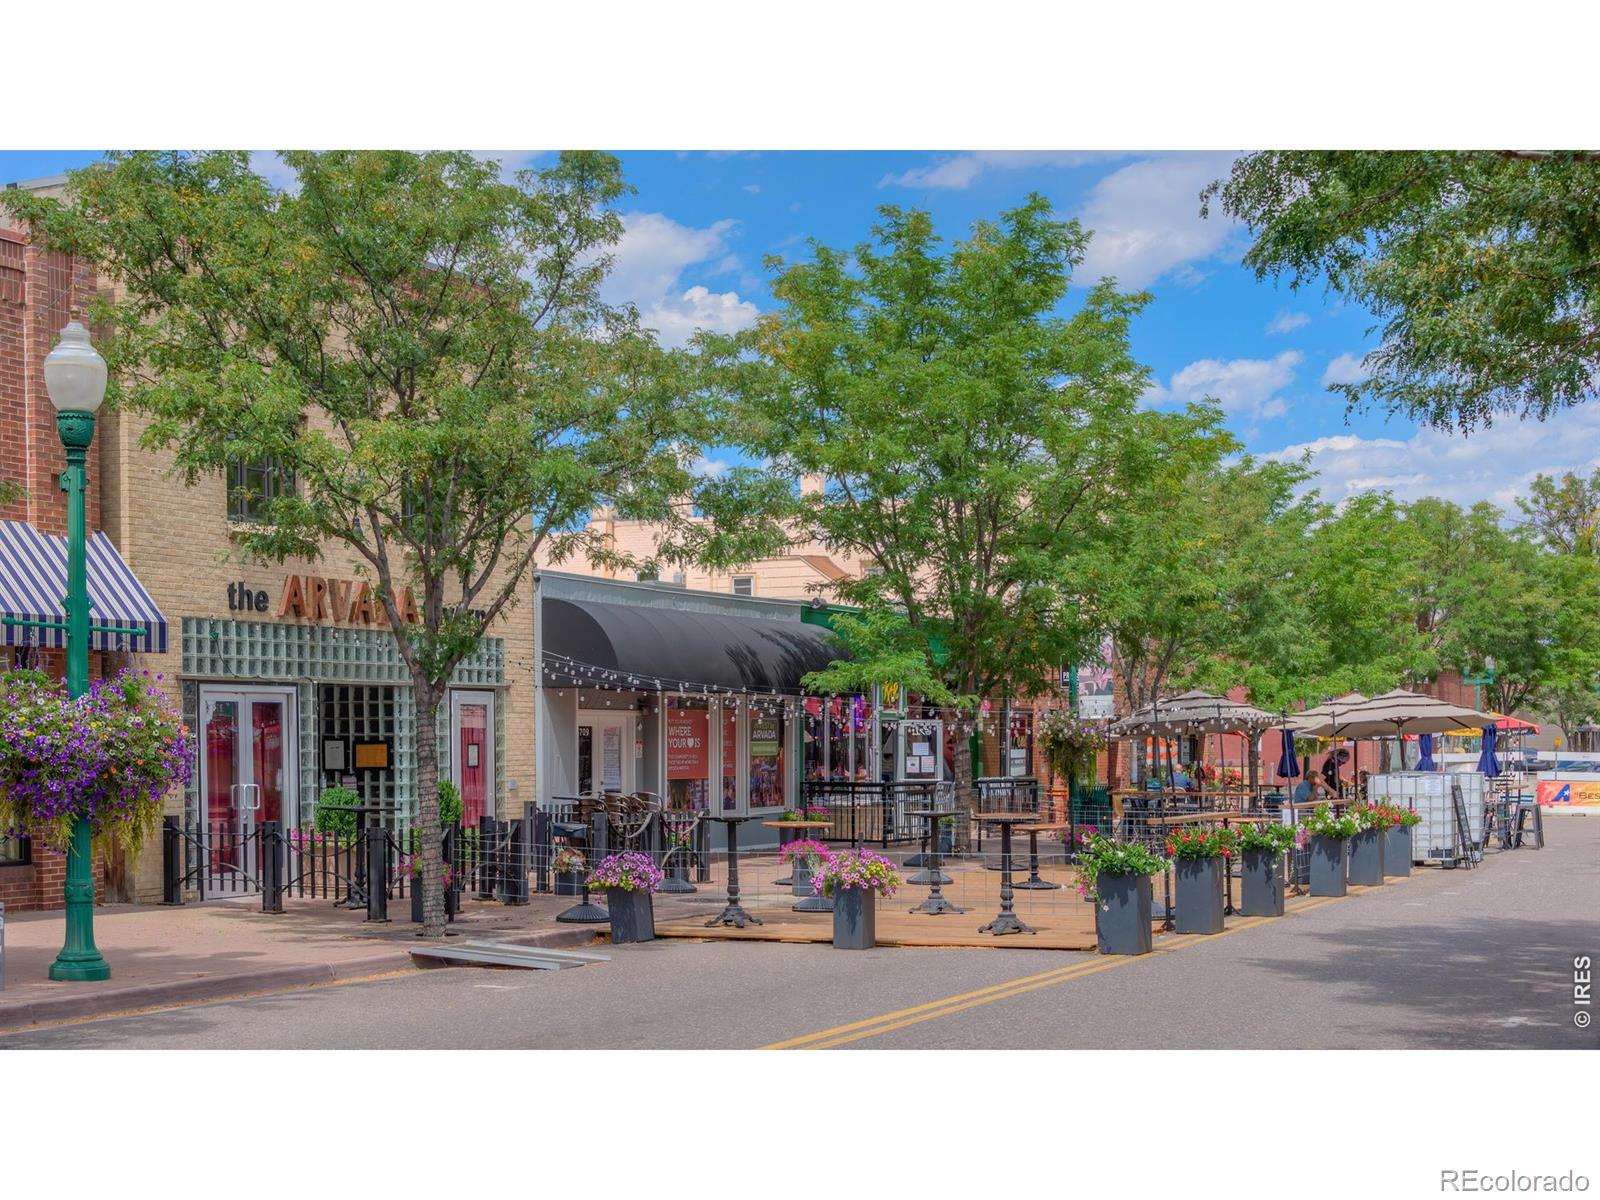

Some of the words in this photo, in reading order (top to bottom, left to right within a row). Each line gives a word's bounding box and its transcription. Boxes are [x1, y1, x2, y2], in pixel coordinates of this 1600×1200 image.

[227, 580, 269, 612] the
[668, 726, 692, 737] WHERE
[752, 730, 777, 740] ARVADA
[668, 738, 687, 749] YOUR
[694, 738, 701, 748] IS
